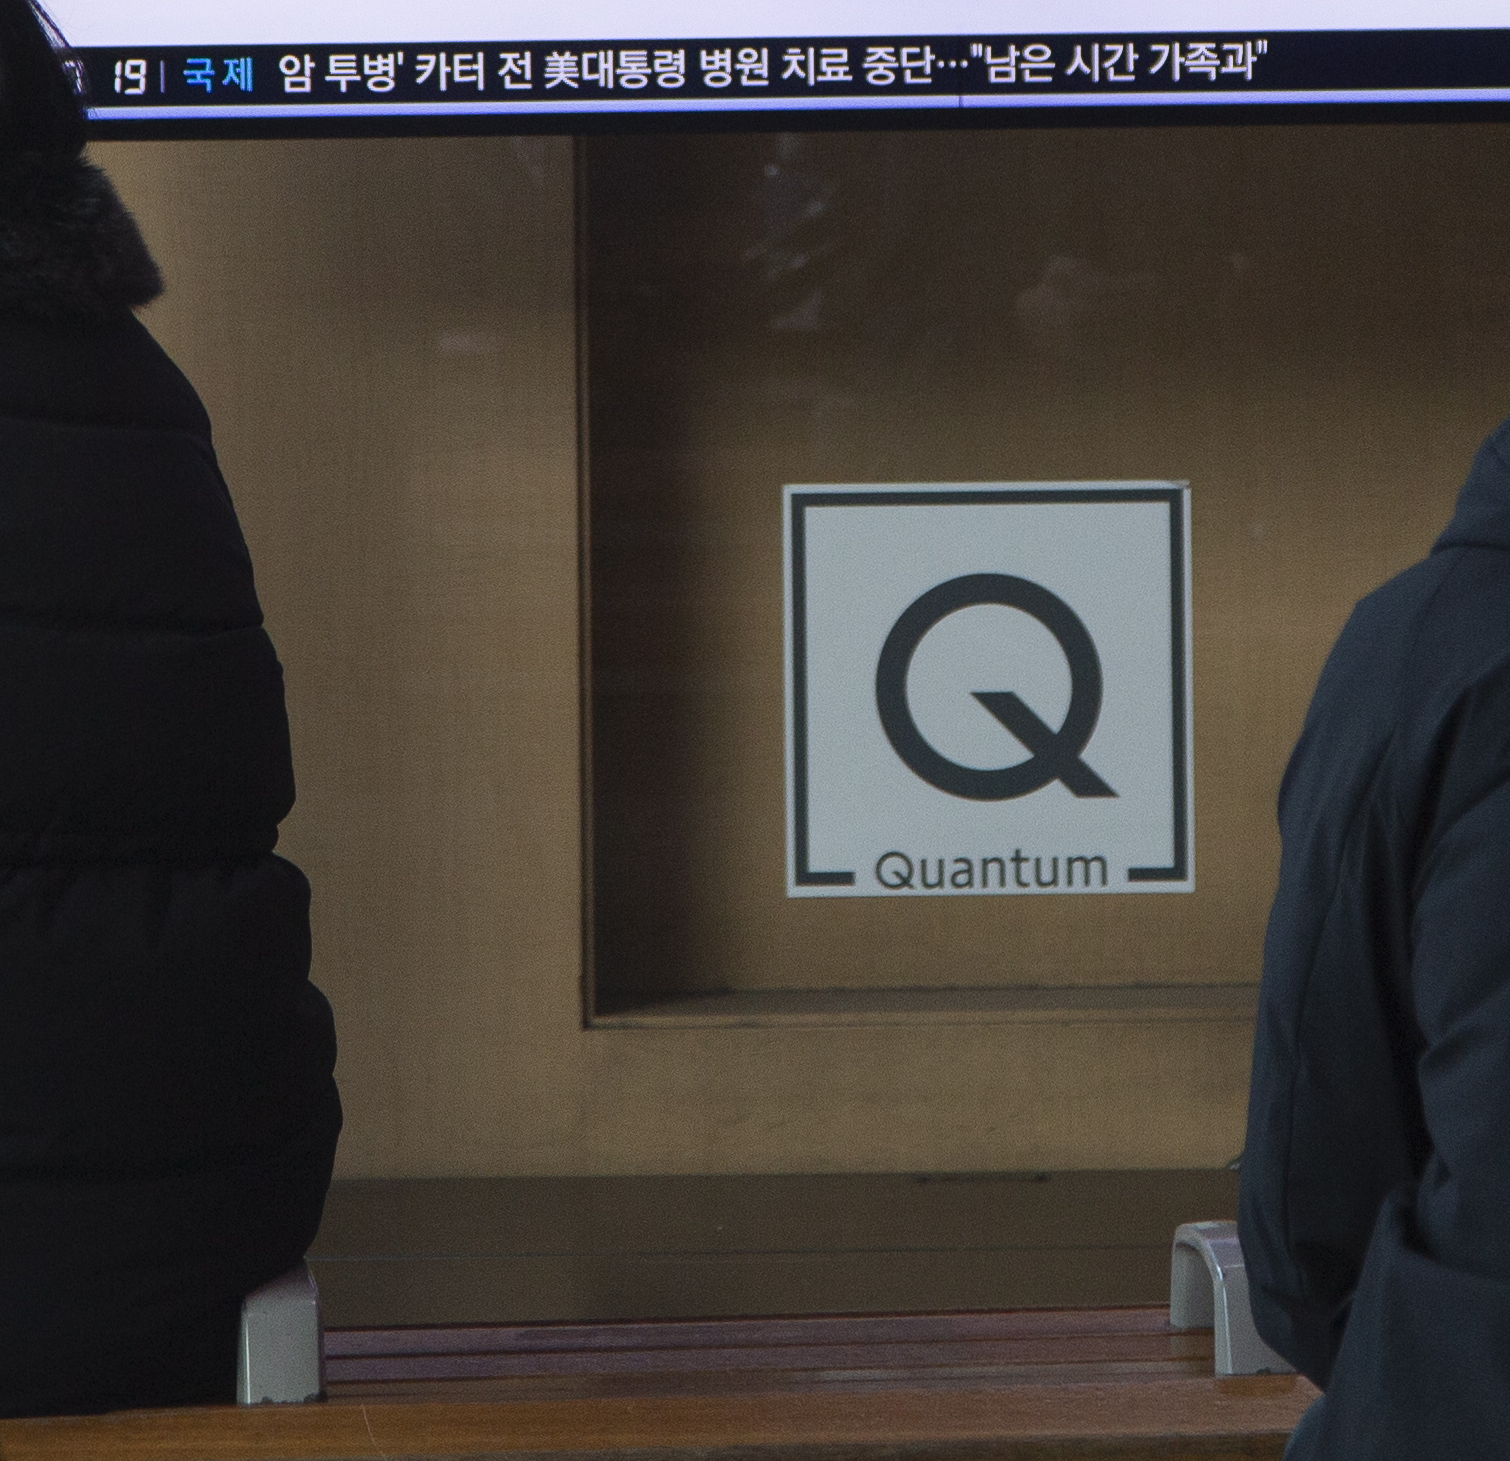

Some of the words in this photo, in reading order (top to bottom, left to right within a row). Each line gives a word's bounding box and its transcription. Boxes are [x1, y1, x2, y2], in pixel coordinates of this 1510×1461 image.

[114, 58, 147, 95] 19
[183, 57, 253, 93] 국제
[278, 53, 316, 93] 암
[415, 51, 485, 92] 카터
[498, 51, 533, 90] 전
[544, 48, 686, 90] 美대통령
[699, 47, 769, 89] 병원
[782, 46, 853, 87] 치료
[1065, 43, 1139, 83] 시간
[874, 572, 1118, 802] Q
[874, 848, 1109, 891] Quantum
